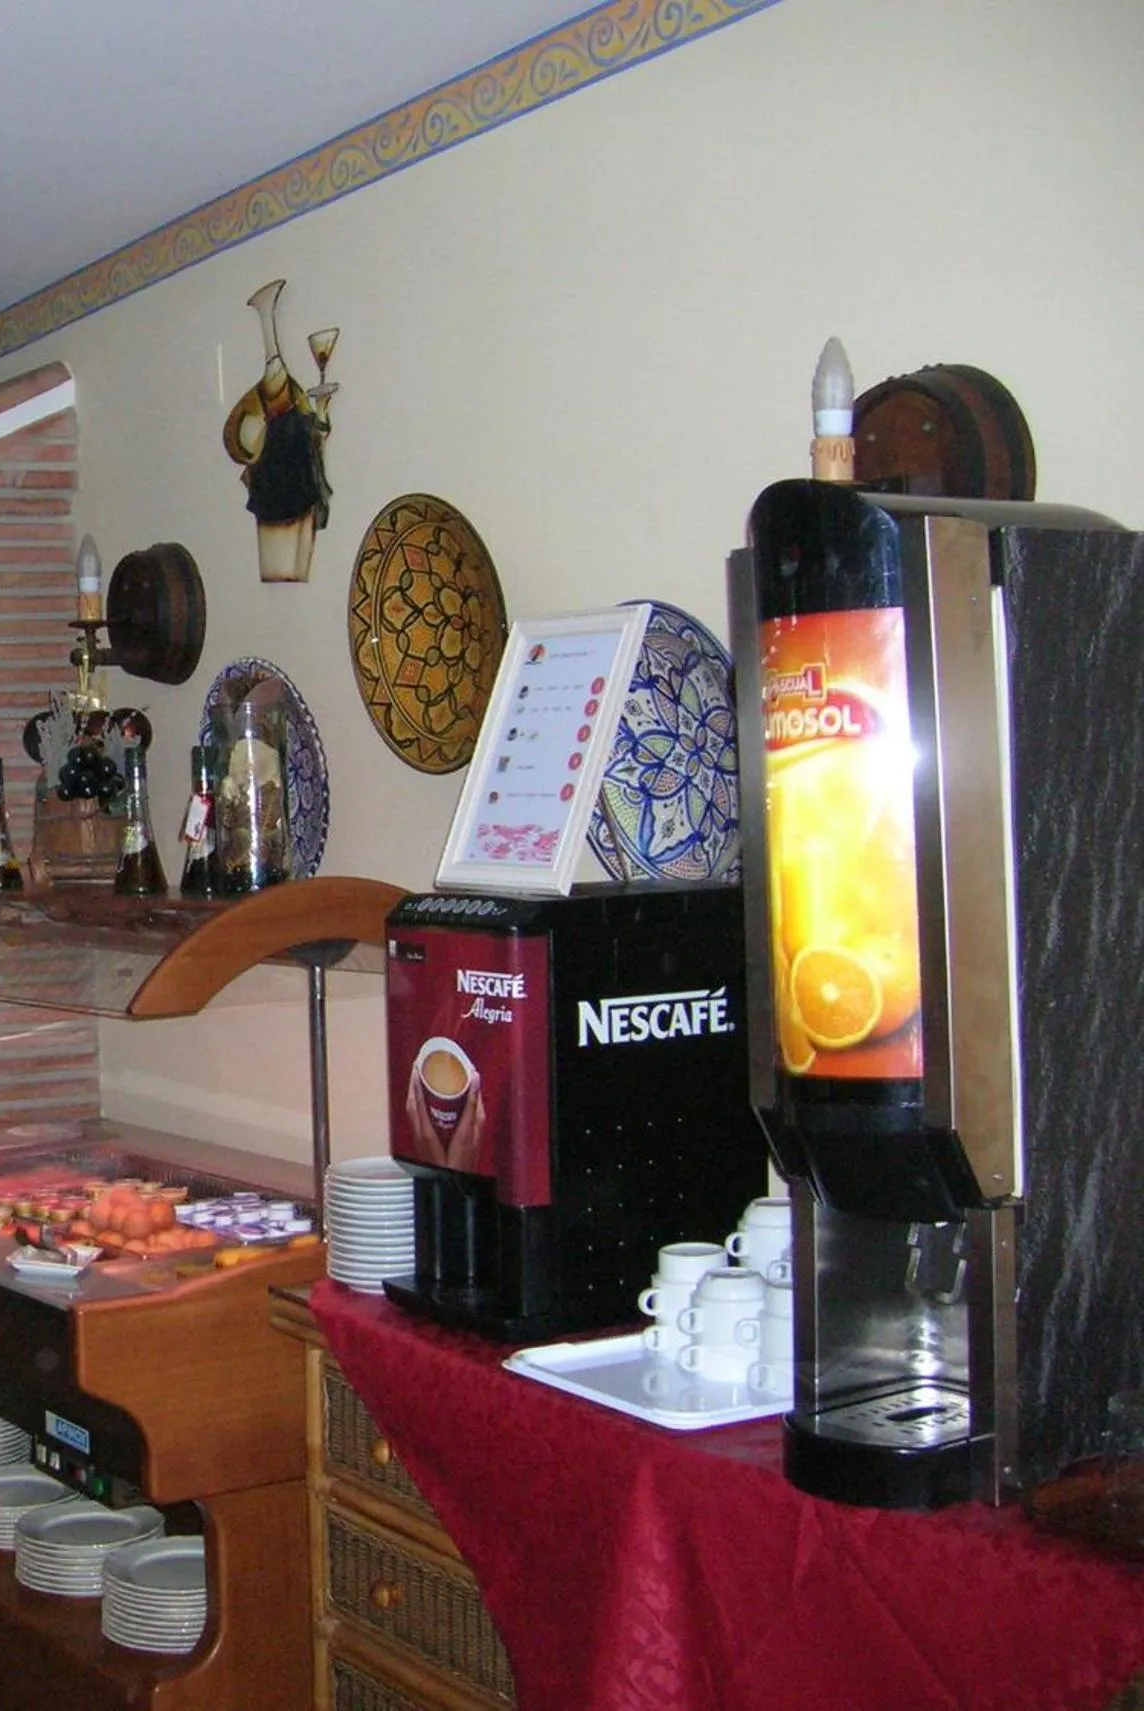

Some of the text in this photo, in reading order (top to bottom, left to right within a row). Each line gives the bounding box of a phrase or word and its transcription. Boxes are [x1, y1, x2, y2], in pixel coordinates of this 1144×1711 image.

[457, 969, 526, 999] NESCAFÉ
[461, 997, 513, 1024] Alegria
[578, 986, 728, 1047] NESCAFÉ
